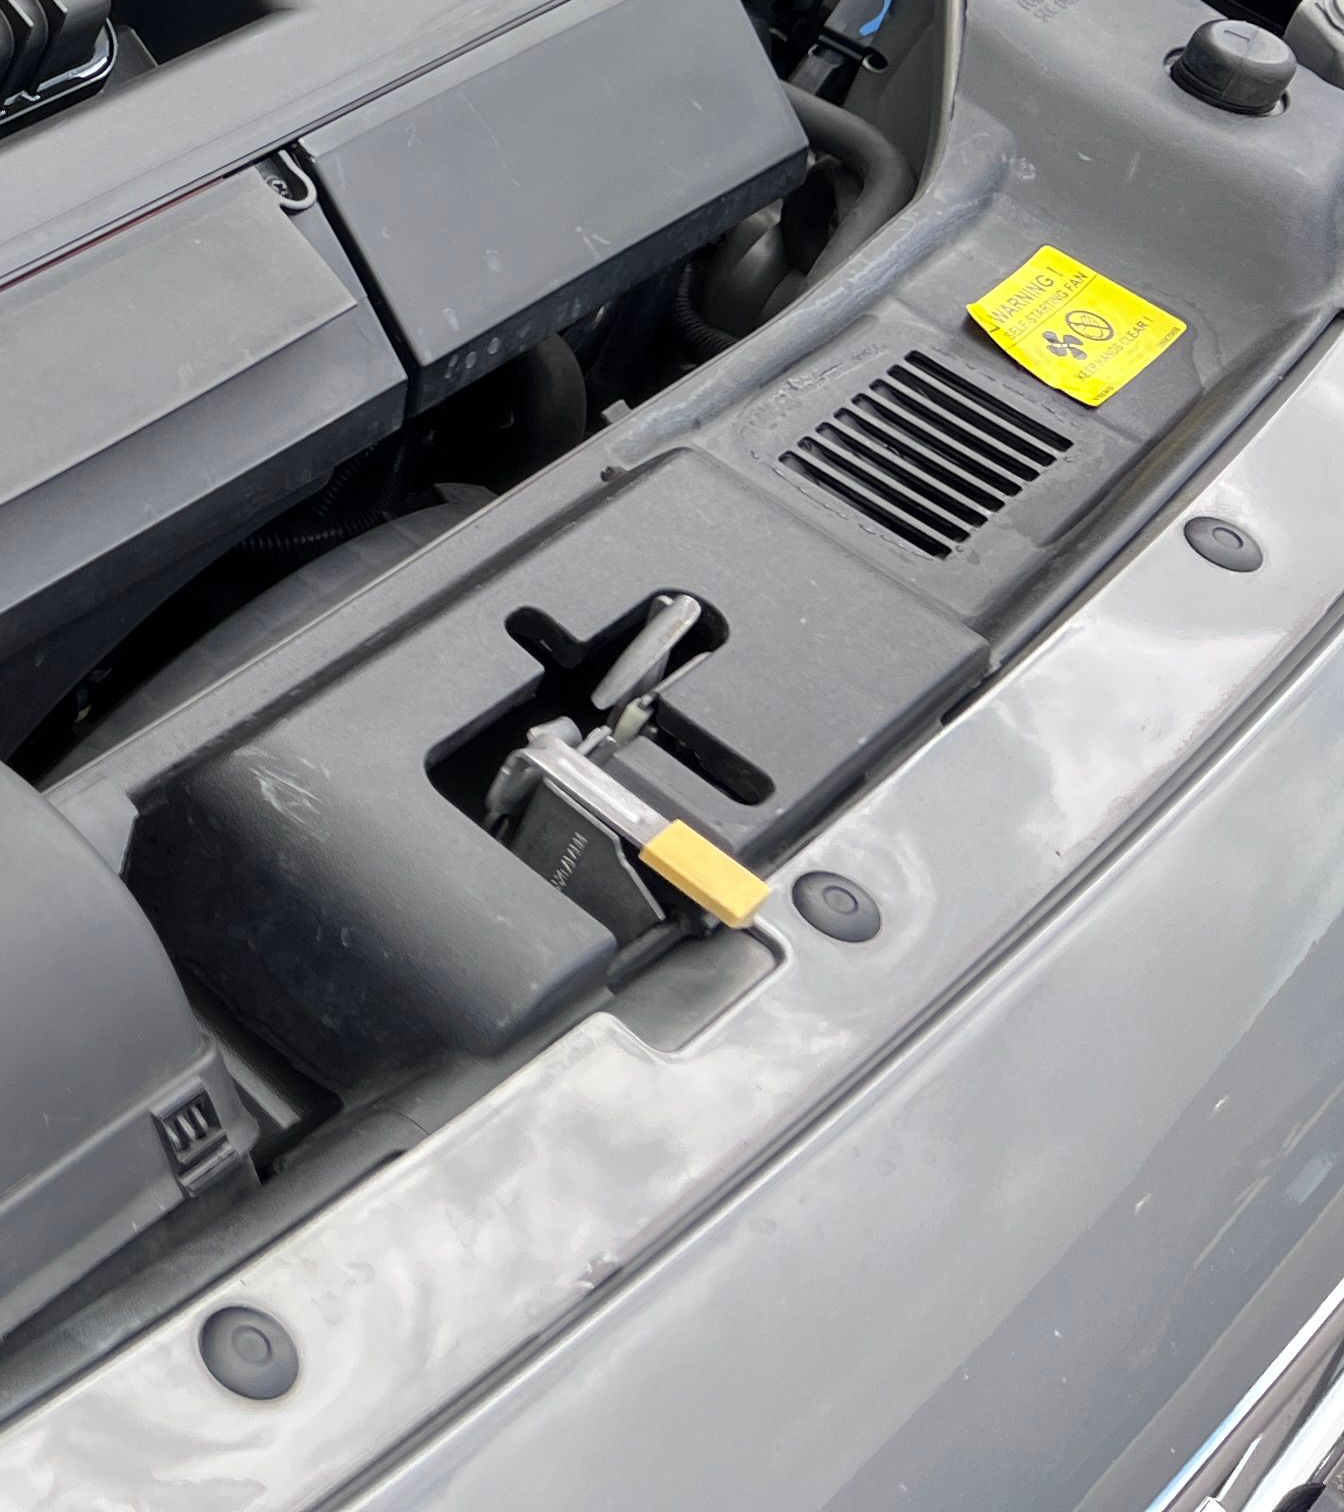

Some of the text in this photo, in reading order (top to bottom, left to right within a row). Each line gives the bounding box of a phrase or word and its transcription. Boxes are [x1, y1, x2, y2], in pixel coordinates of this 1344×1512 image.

[984, 272, 1058, 326] WARNING
[1059, 270, 1090, 292] FAN
[1073, 360, 1101, 383] KEEP
[1115, 318, 1150, 347] CLEAR
